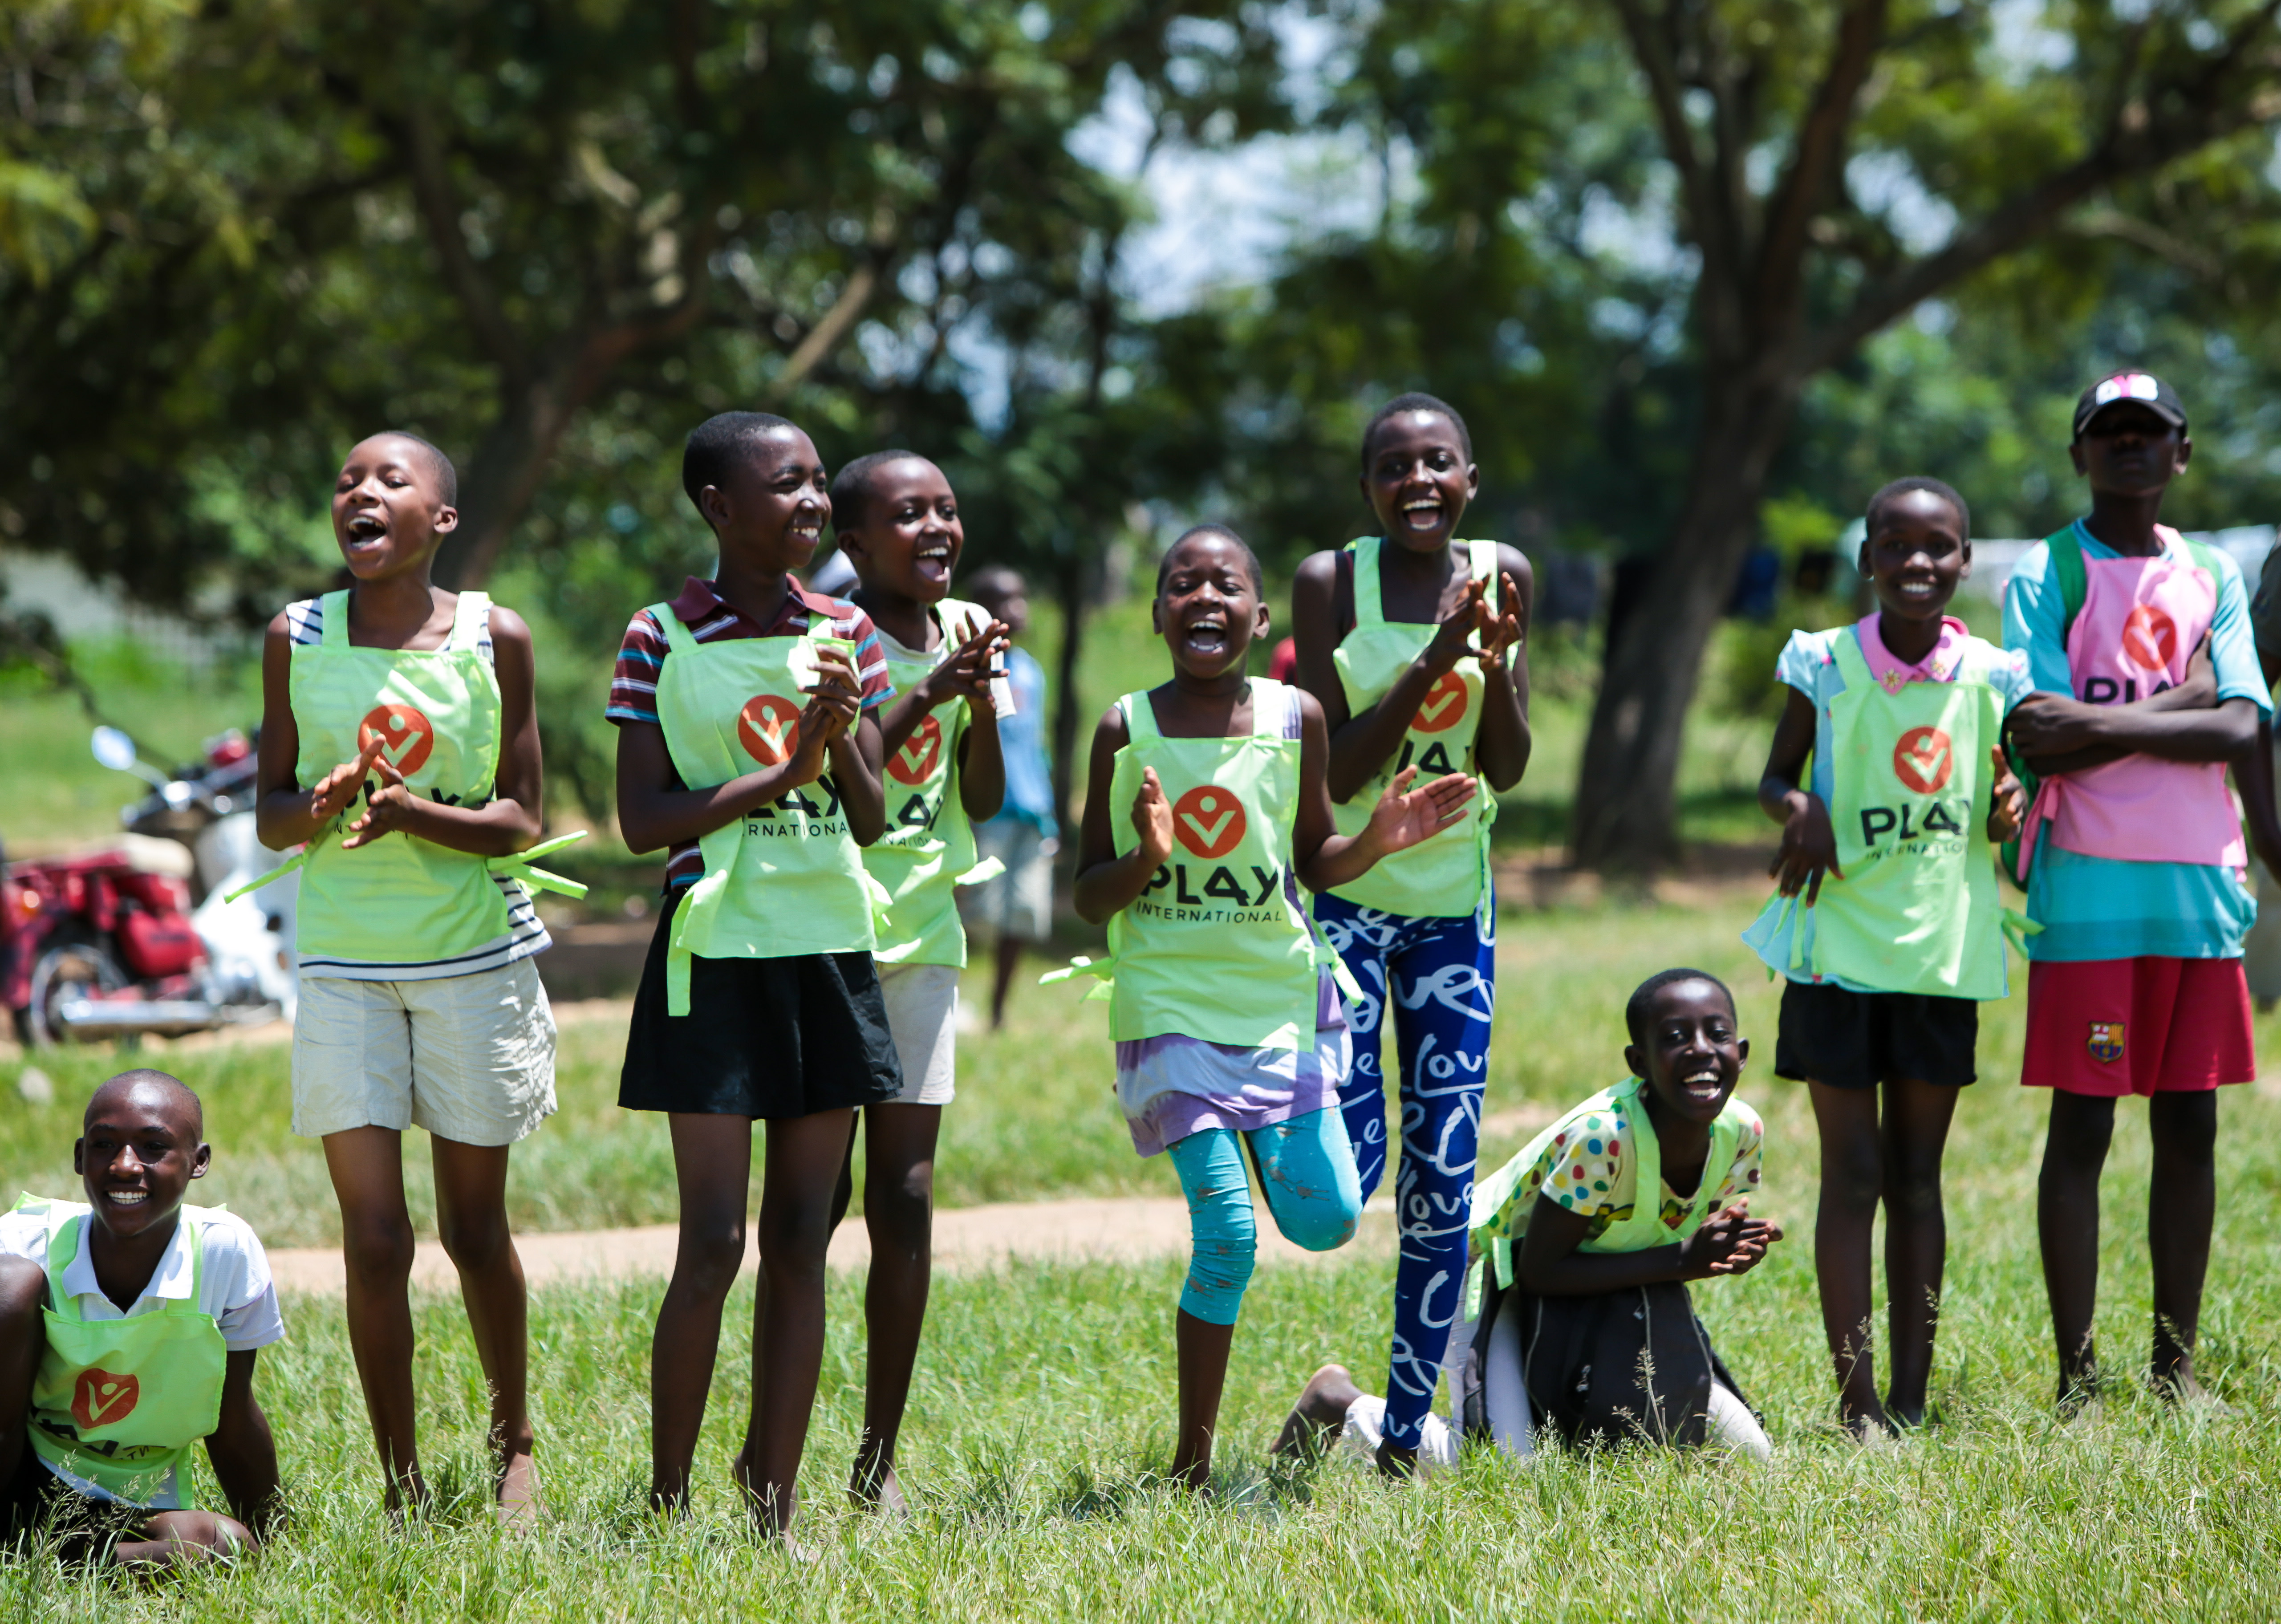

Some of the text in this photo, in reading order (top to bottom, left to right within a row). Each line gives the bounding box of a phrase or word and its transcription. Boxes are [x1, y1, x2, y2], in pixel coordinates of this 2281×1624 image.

[1860, 800, 1971, 846] PLA
[1140, 864, 1278, 906] PLAY
[1136, 900, 1283, 923] INTERNATIONAL
